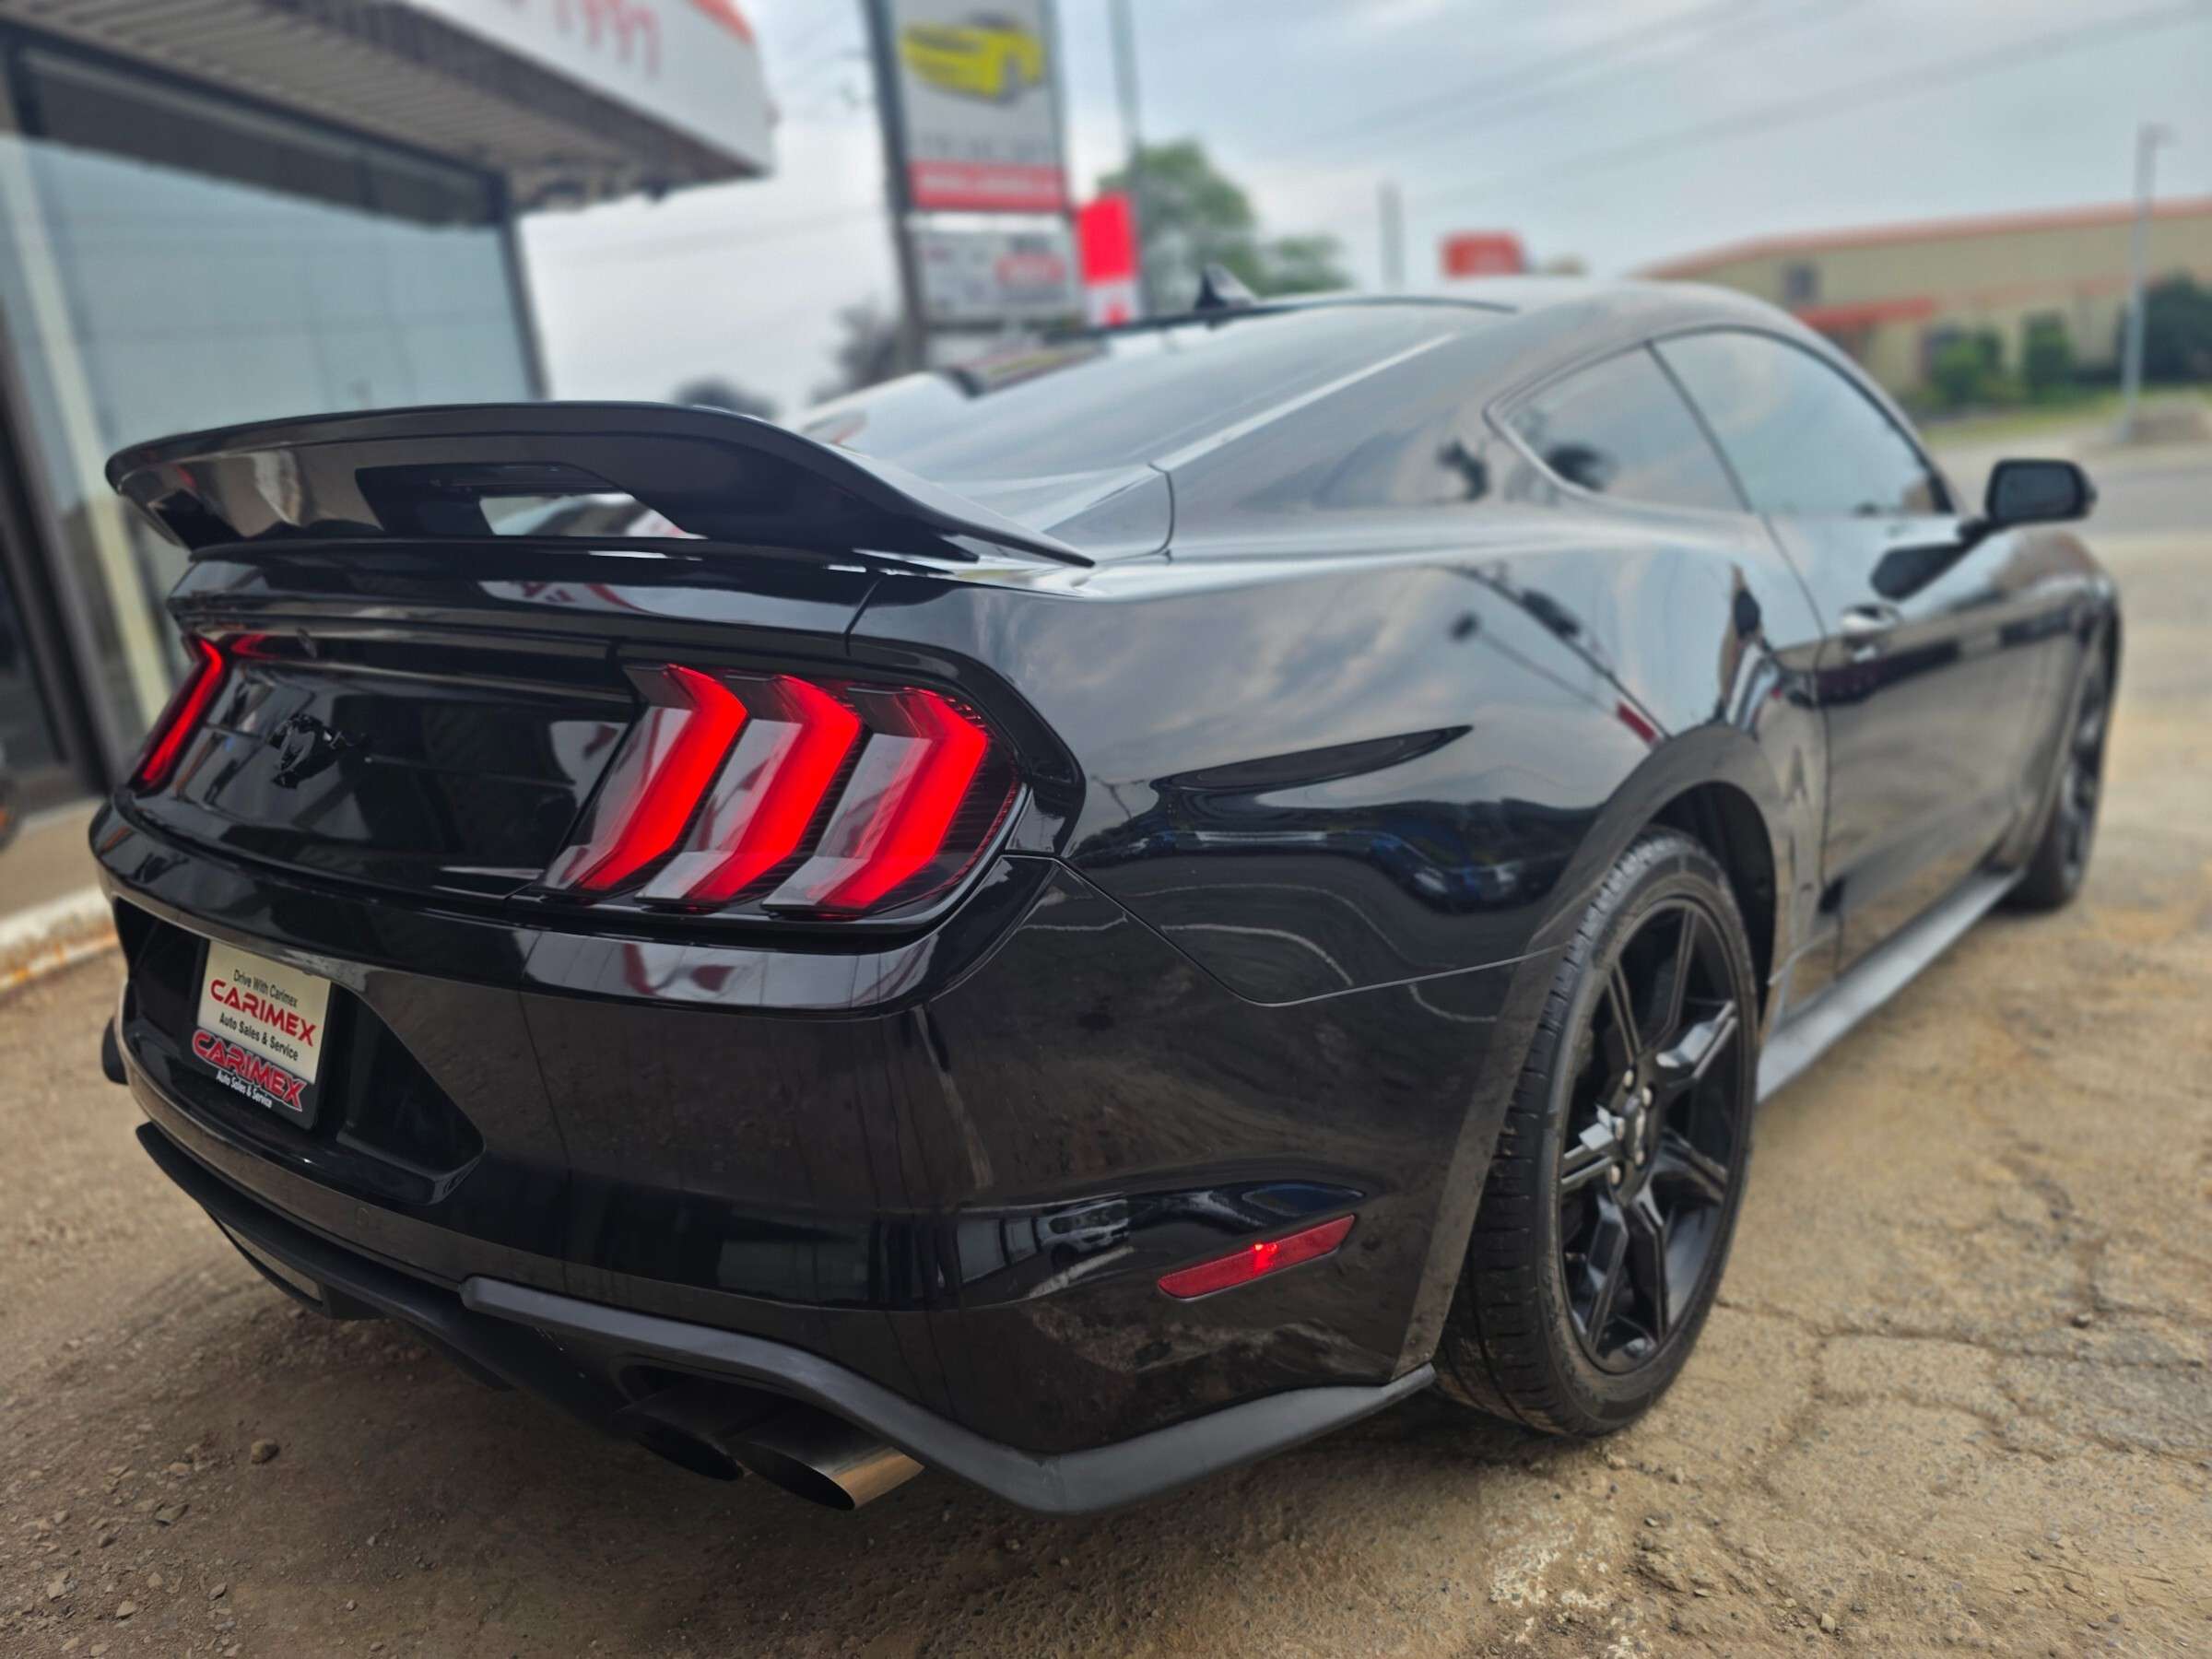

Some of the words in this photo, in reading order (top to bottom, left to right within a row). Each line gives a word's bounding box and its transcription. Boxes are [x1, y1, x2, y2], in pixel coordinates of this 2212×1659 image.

[234, 969, 252, 987] Drive
[253, 976, 268, 994] With
[210, 979, 316, 1047] CARIMEX
[219, 1012, 237, 1030] Auto
[239, 1020, 260, 1041] Sales
[262, 1031, 268, 1045] &
[270, 1035, 299, 1061] Service
[193, 1030, 307, 1111] CARIMEX
